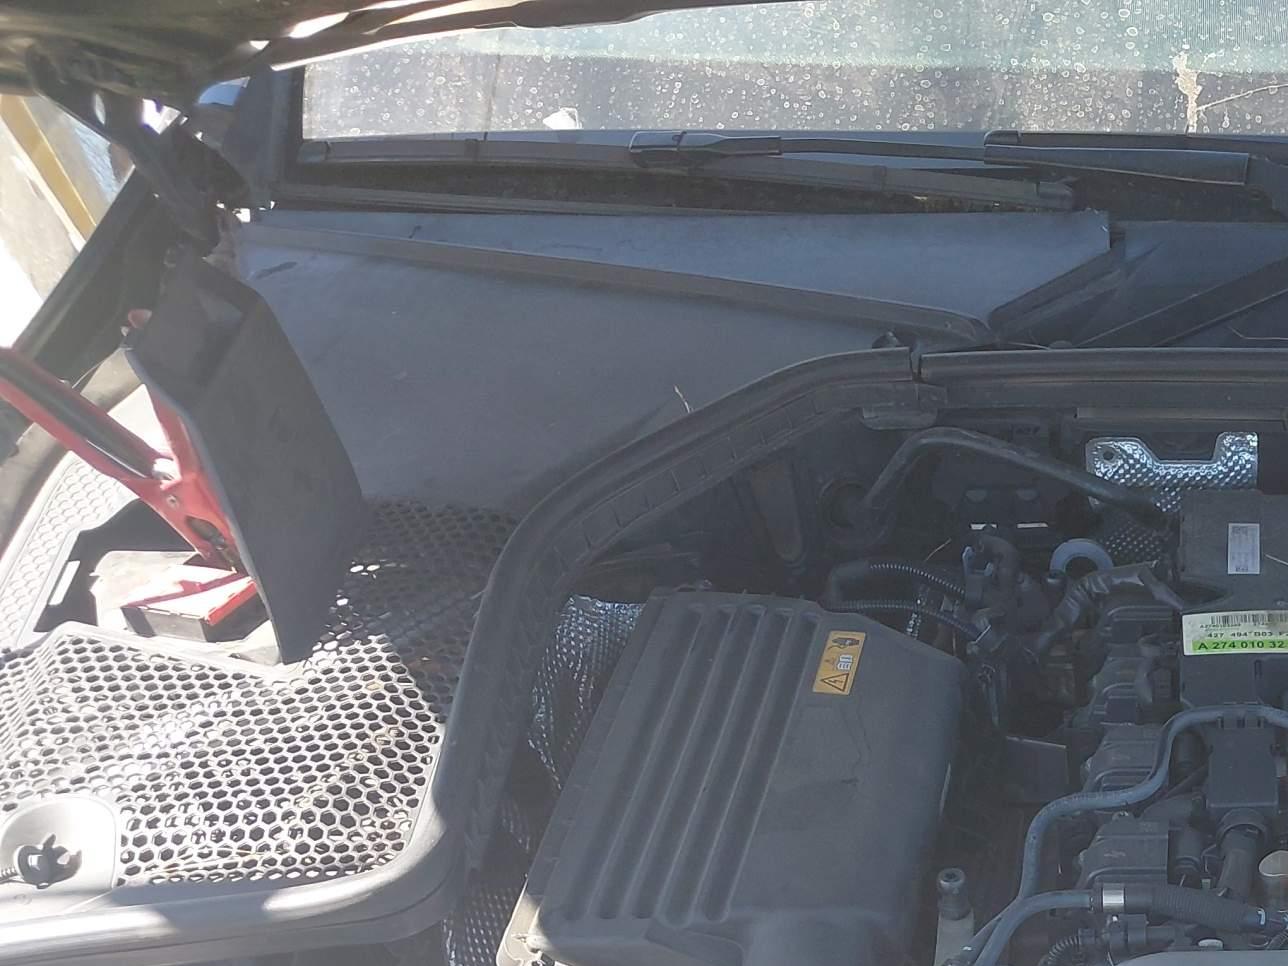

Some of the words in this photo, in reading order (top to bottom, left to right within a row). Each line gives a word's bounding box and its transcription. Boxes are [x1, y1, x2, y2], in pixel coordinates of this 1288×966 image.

[1198, 642, 1208, 650] A
[1212, 641, 1236, 649] 274
[1240, 641, 1264, 649] 010
[1269, 641, 1284, 649] 32
